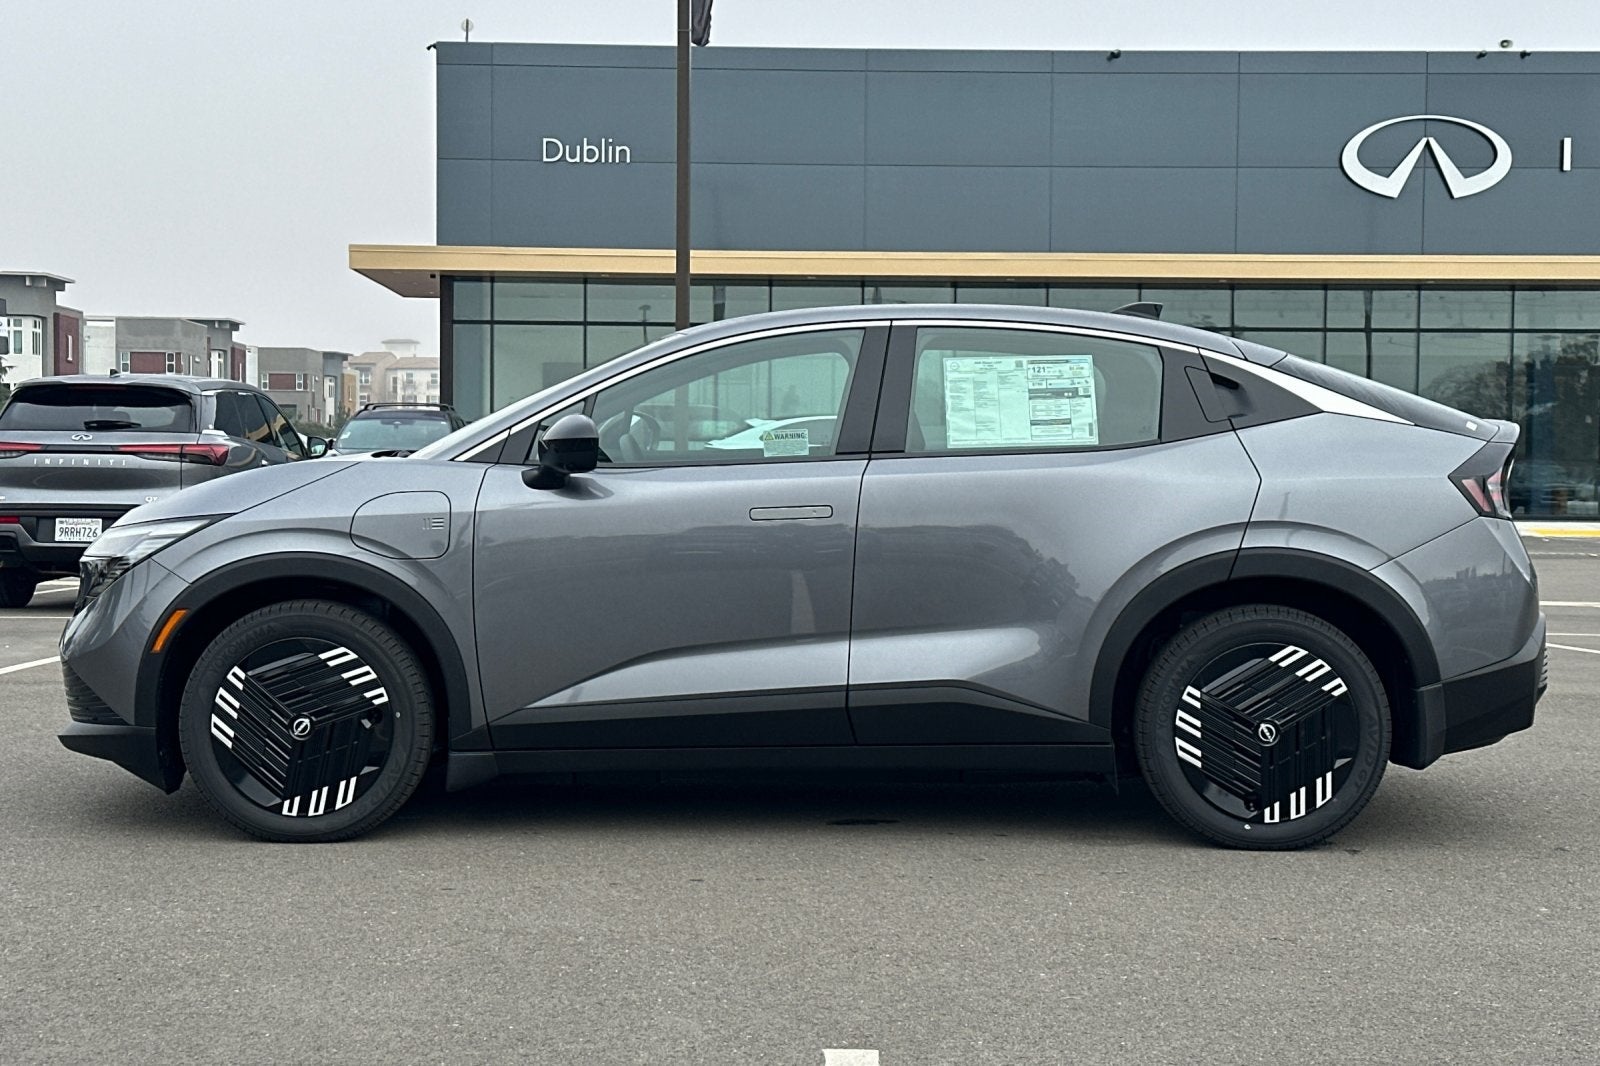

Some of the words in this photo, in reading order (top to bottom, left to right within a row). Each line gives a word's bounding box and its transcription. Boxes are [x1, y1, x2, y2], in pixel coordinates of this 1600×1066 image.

[543, 137, 630, 163] Dublin
[1032, 366, 1046, 374] 121
[34, 458, 126, 466] INFINITI
[59, 526, 98, 537] 9RRH726
[1364, 712, 1378, 767] AVID
